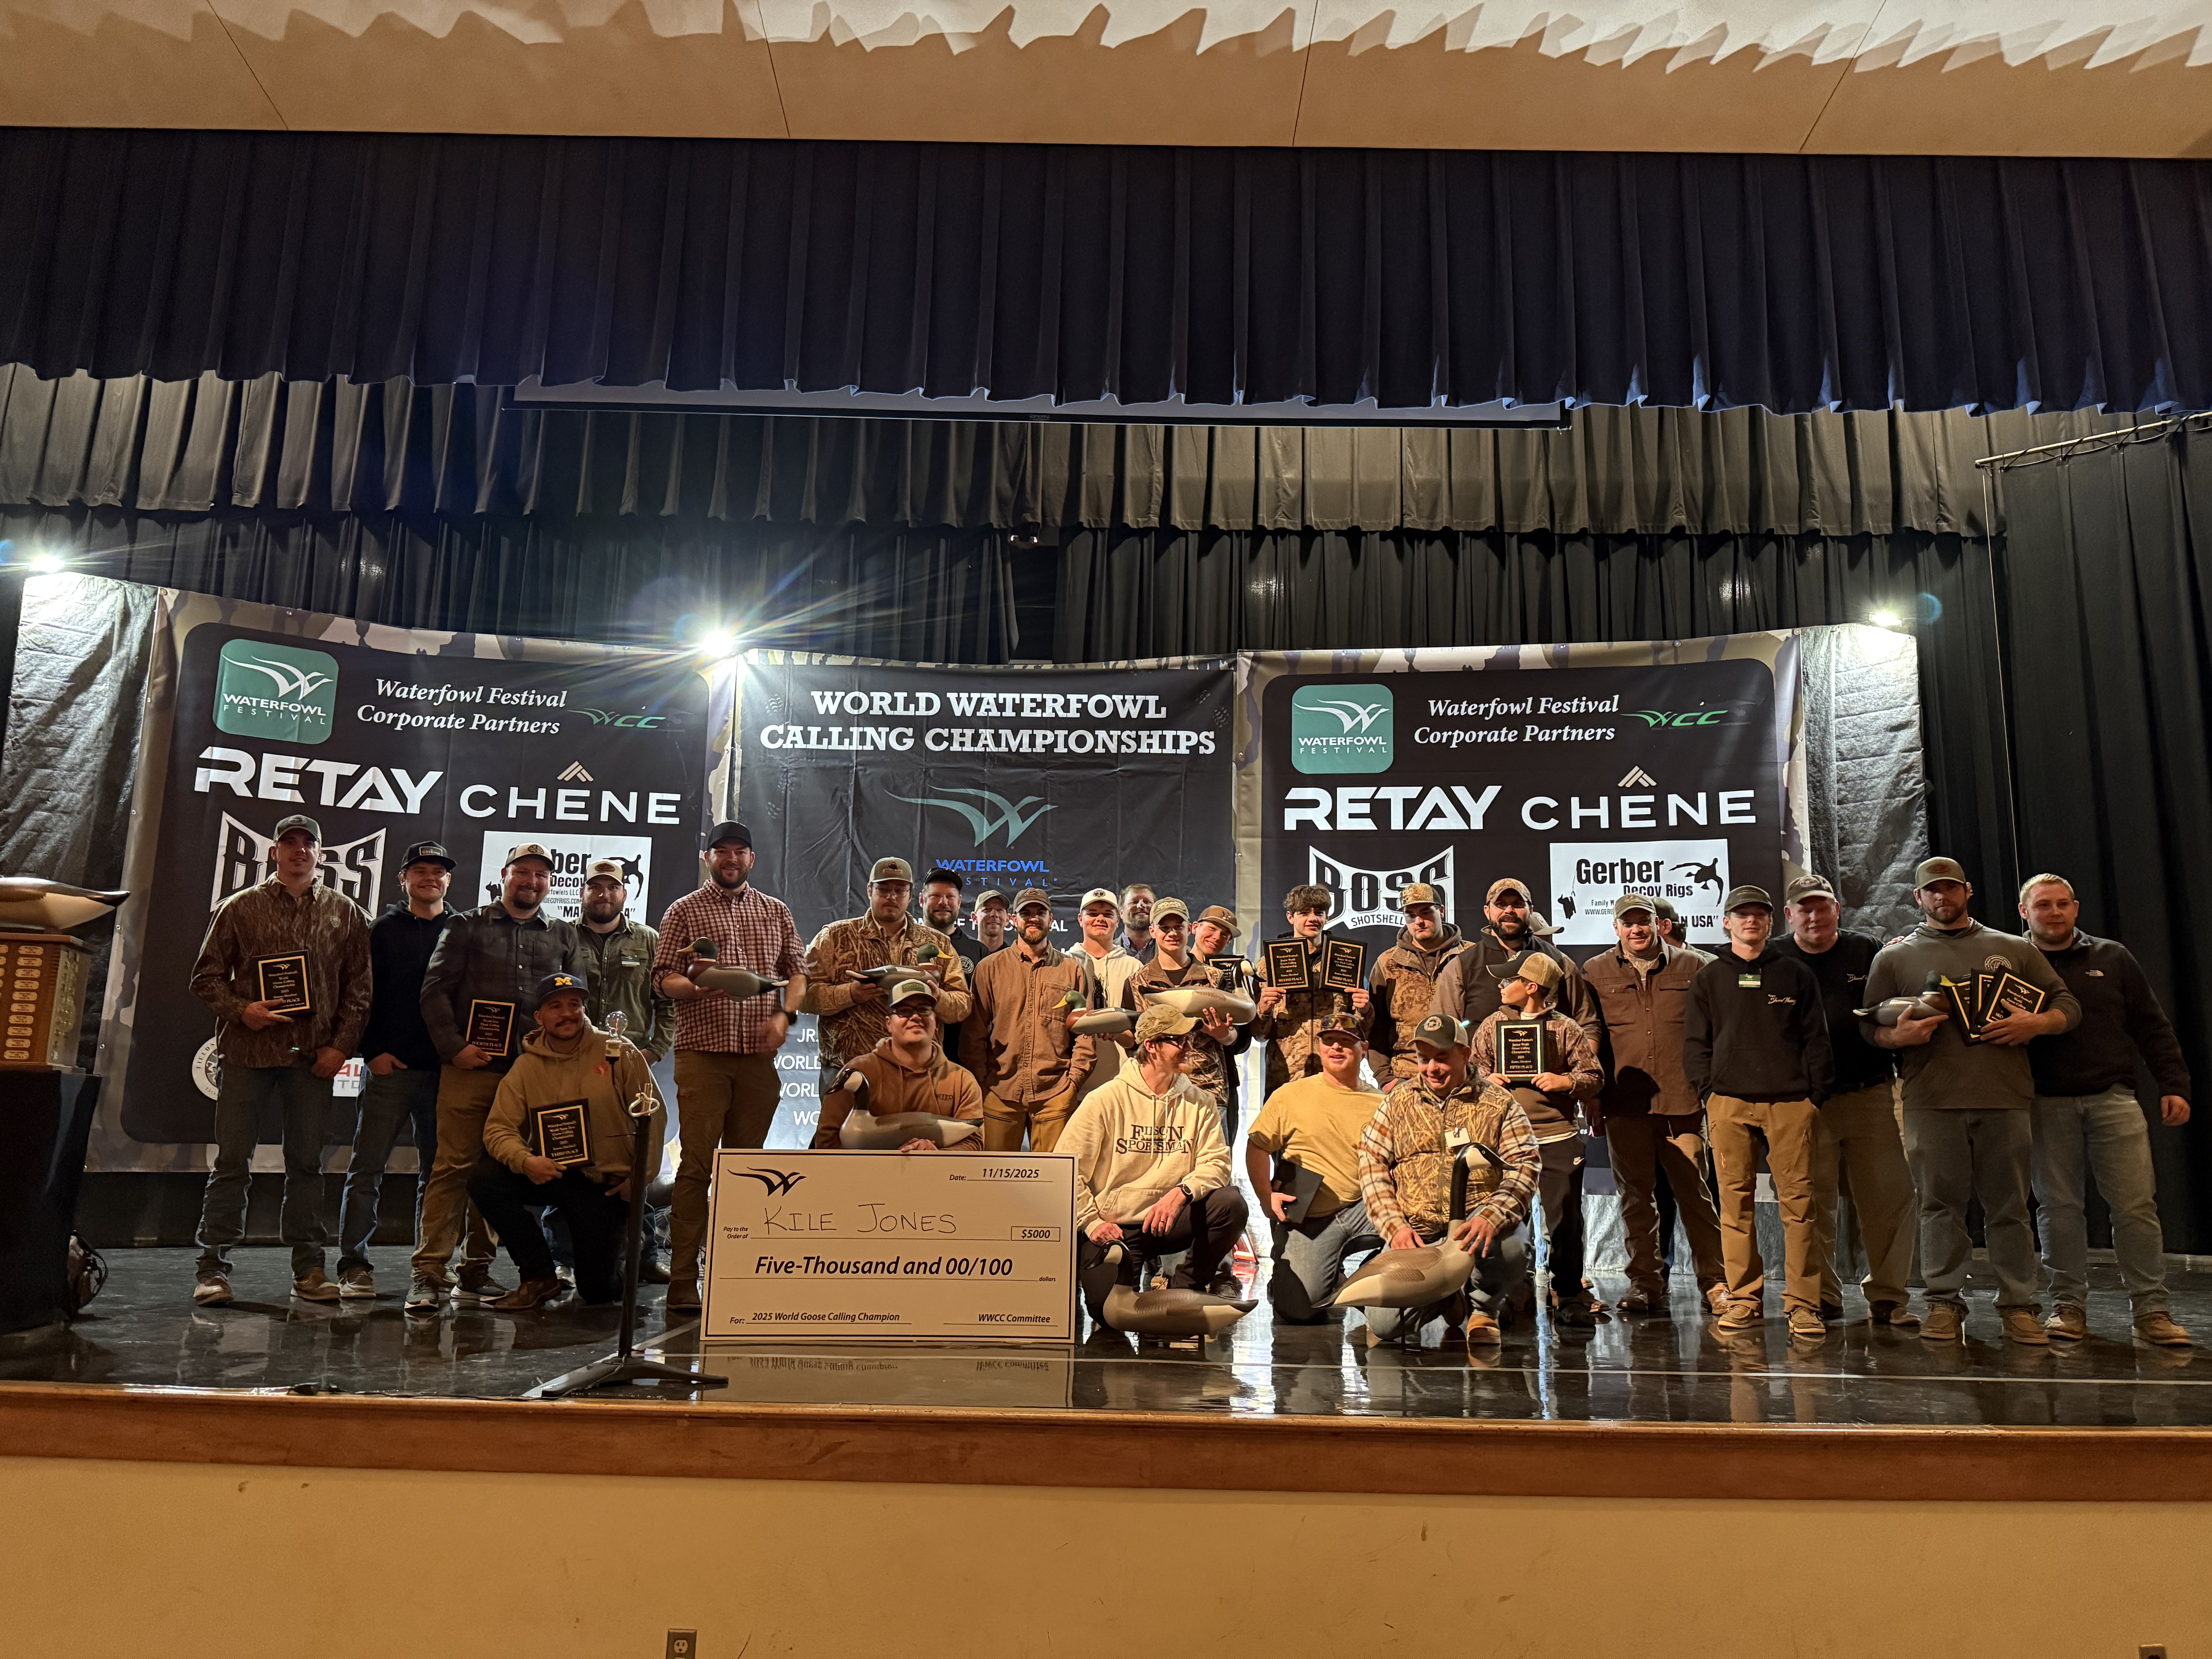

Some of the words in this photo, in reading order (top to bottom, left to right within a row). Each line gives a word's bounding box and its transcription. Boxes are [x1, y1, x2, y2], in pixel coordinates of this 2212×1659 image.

[223, 693, 326, 716] WATERFOWL
[376, 678, 483, 706] Waterfowl
[486, 687, 567, 708] Festival
[811, 691, 940, 716] WORLD
[947, 692, 1166, 718] WATERFOWL
[223, 705, 326, 725] FESTIVAL
[1428, 697, 1532, 720] Waterfowl
[1538, 695, 1619, 714] Festival
[357, 705, 464, 730] Corporate
[469, 713, 560, 734] Partners
[760, 725, 914, 751] CALLING
[925, 729, 1215, 754] CHAMPIONSHIPS
[1298, 737, 1386, 745] WATERFOWL
[1415, 726, 1518, 748] Corporate
[1523, 725, 1615, 742] Partners
[194, 746, 443, 814] RETAY
[1285, 785, 1502, 830] RETAY
[215, 818, 382, 917] BSS
[551, 849, 592, 874] ber
[936, 859, 1049, 873] WATERFOWL
[1577, 858, 1664, 884] Gerber
[965, 877, 1049, 886] STIVAL
[1623, 884, 1661, 897] Decoy
[1666, 884, 1693, 898] Rigs
[555, 977, 573, 986] M
[1115, 1138, 1193, 1154] SPORTSMAN
[982, 1168, 1039, 1180] 11/15/2025
[764, 1206, 836, 1235] KILE
[857, 1203, 957, 1233] JONES
[1021, 1229, 1051, 1239] $5000
[755, 1255, 900, 1274] Five-Thousand
[903, 1256, 942, 1274] and
[946, 1257, 1013, 1276] 00/100
[752, 1312, 773, 1321] 2025
[775, 1312, 799, 1321] World
[800, 1312, 826, 1321] Goose
[828, 1312, 856, 1322] Calling
[858, 1312, 900, 1322] Champion
[979, 1314, 1006, 1322] WWCC
[1006, 1314, 1051, 1322] Committee
